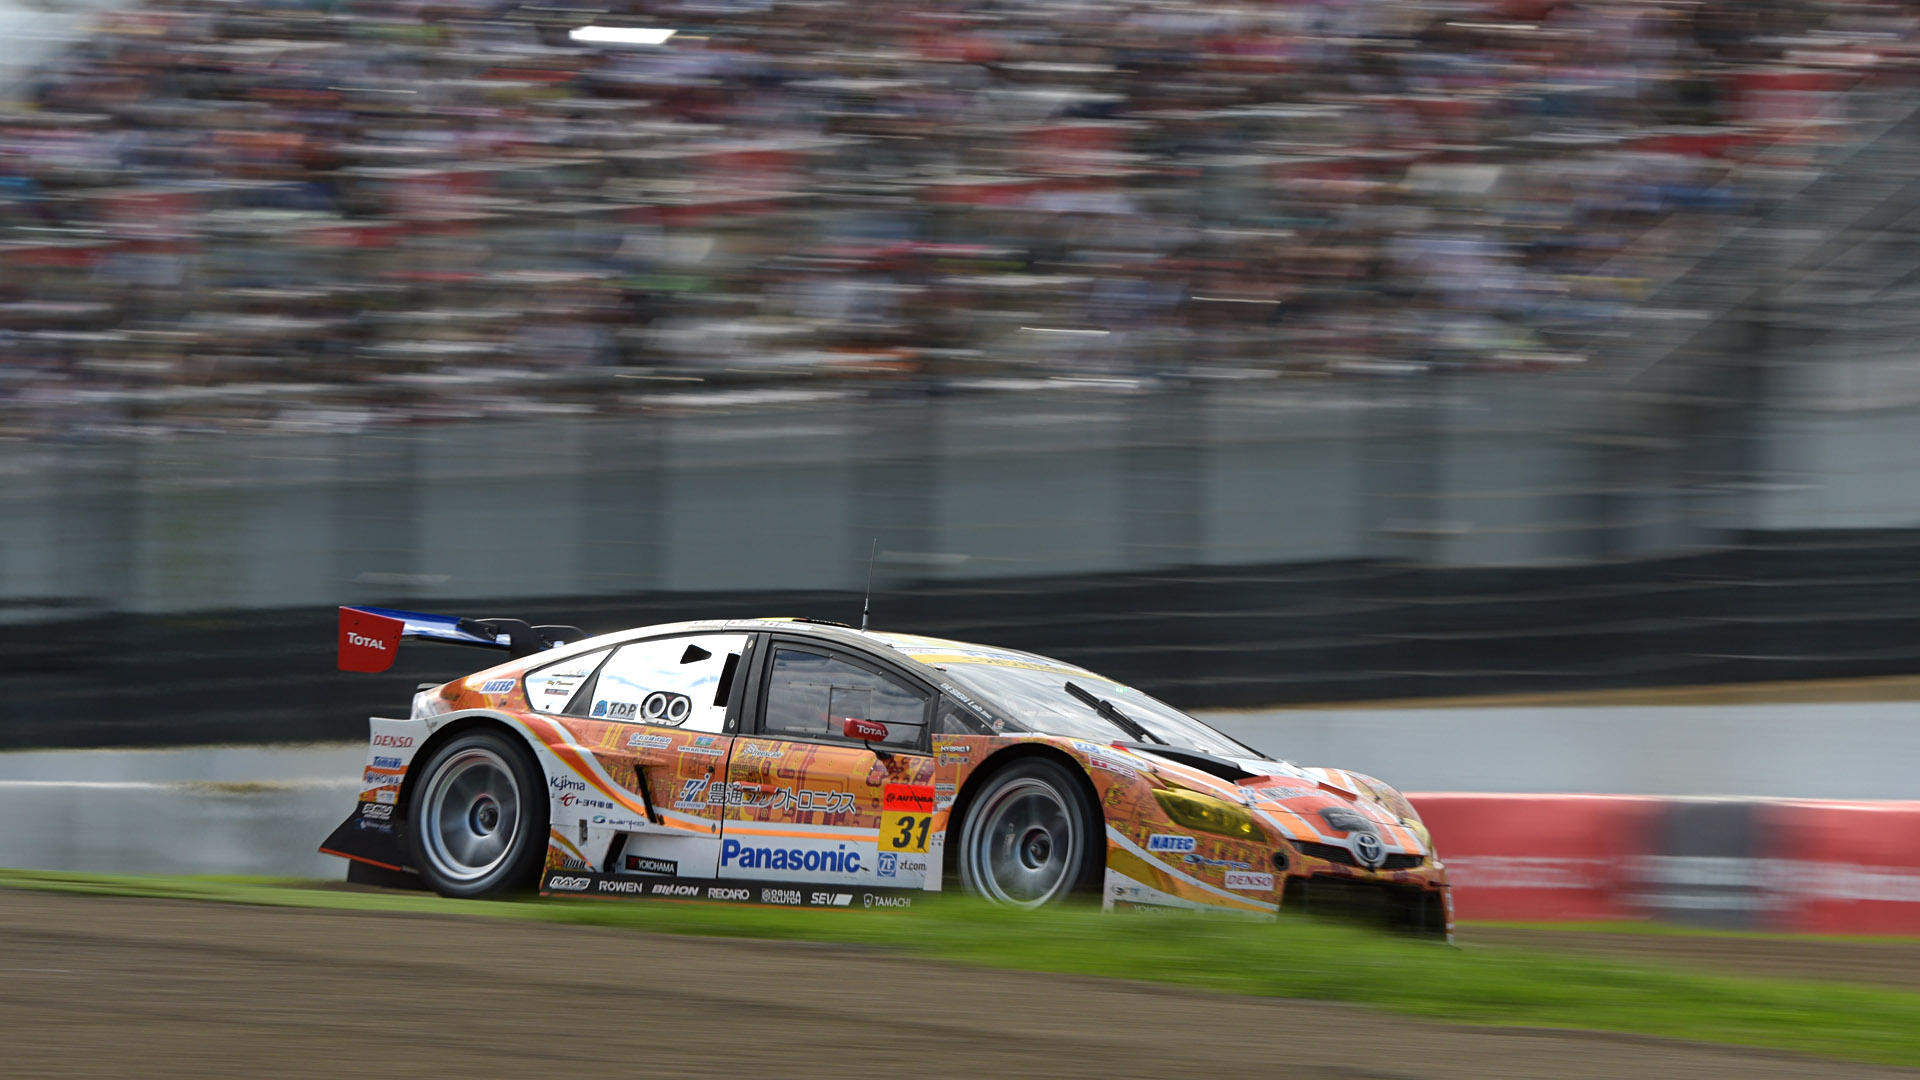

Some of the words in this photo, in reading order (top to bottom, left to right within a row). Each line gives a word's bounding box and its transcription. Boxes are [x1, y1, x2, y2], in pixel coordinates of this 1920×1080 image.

[347, 632, 387, 650] TOTAL
[481, 682, 514, 693] NATEC
[857, 724, 886, 737] TOTAL
[373, 735, 413, 748] DENSO
[892, 816, 932, 850] 31
[721, 839, 861, 873] Panasonic
[637, 859, 674, 873] YOKOHAMA
[881, 858, 896, 871] ZF
[899, 860, 926, 871] zf.com
[597, 881, 641, 893] ROWEN
[1227, 875, 1273, 887] DENSO
[707, 888, 750, 900] RECARO
[770, 896, 800, 904] CLUTCH
[810, 892, 833, 905] SEV
[874, 896, 910, 908] TAMACHI
